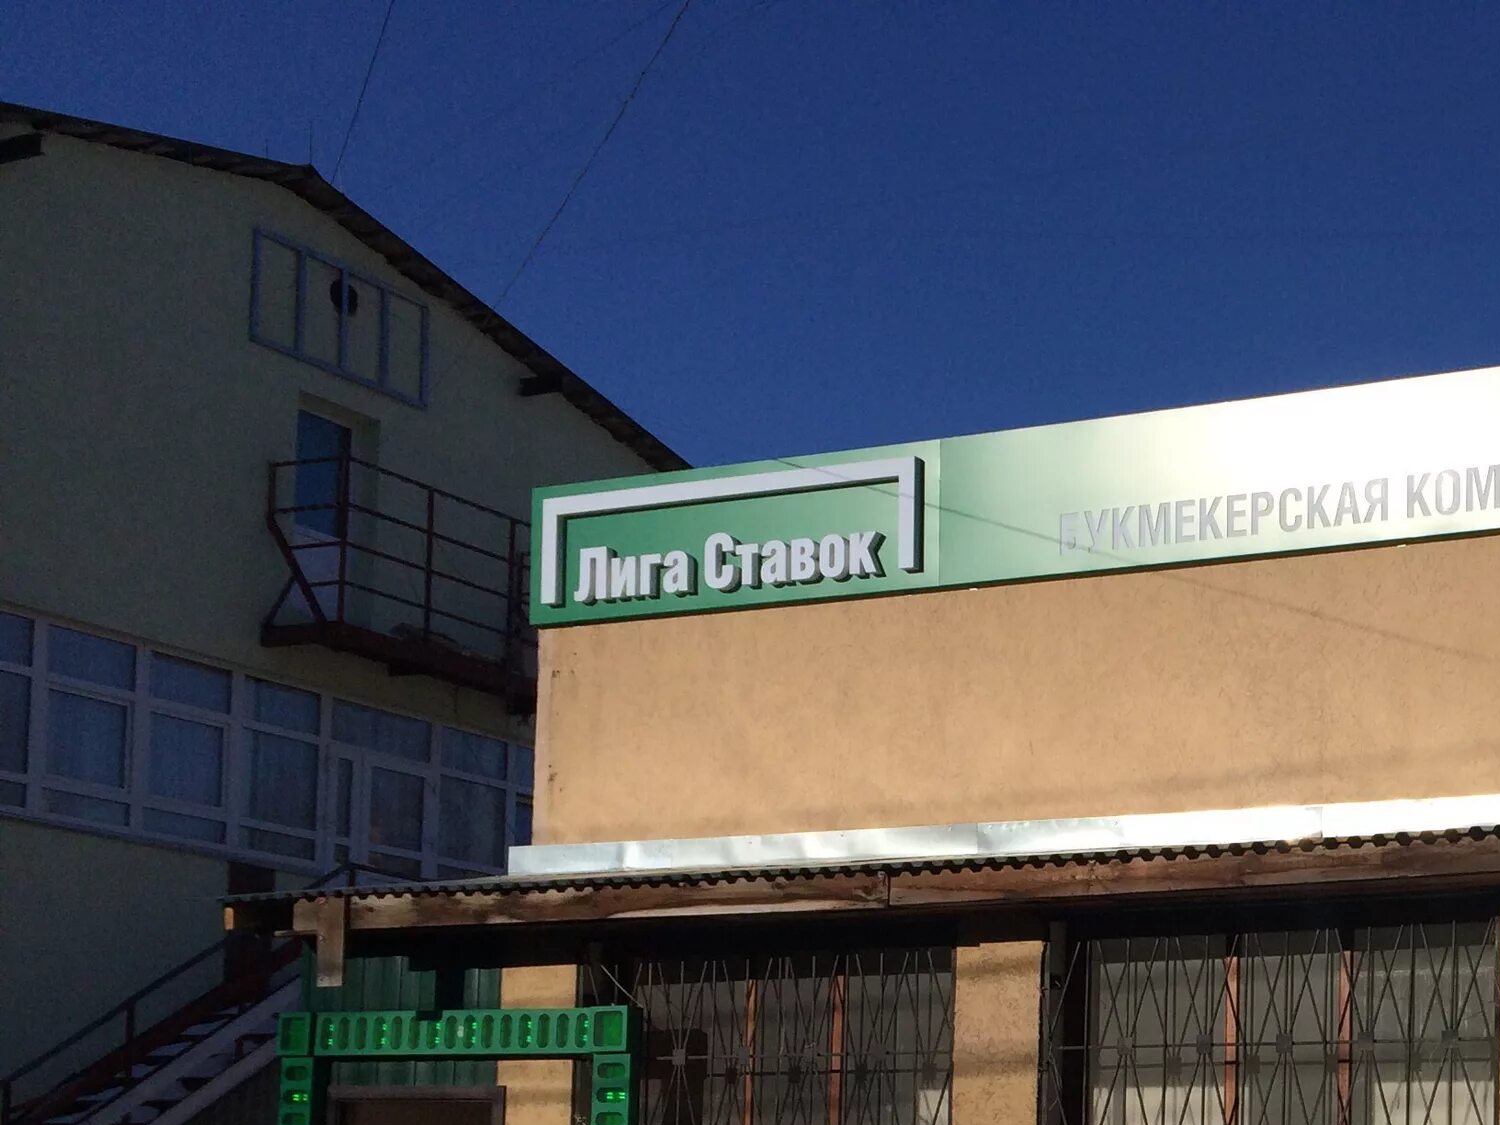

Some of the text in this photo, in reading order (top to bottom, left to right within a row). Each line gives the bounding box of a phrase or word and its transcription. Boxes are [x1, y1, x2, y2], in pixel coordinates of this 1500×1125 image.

[1058, 478, 1389, 556] БУКМЕКЕРСКАЯ
[574, 531, 882, 602] Лига Ставок
